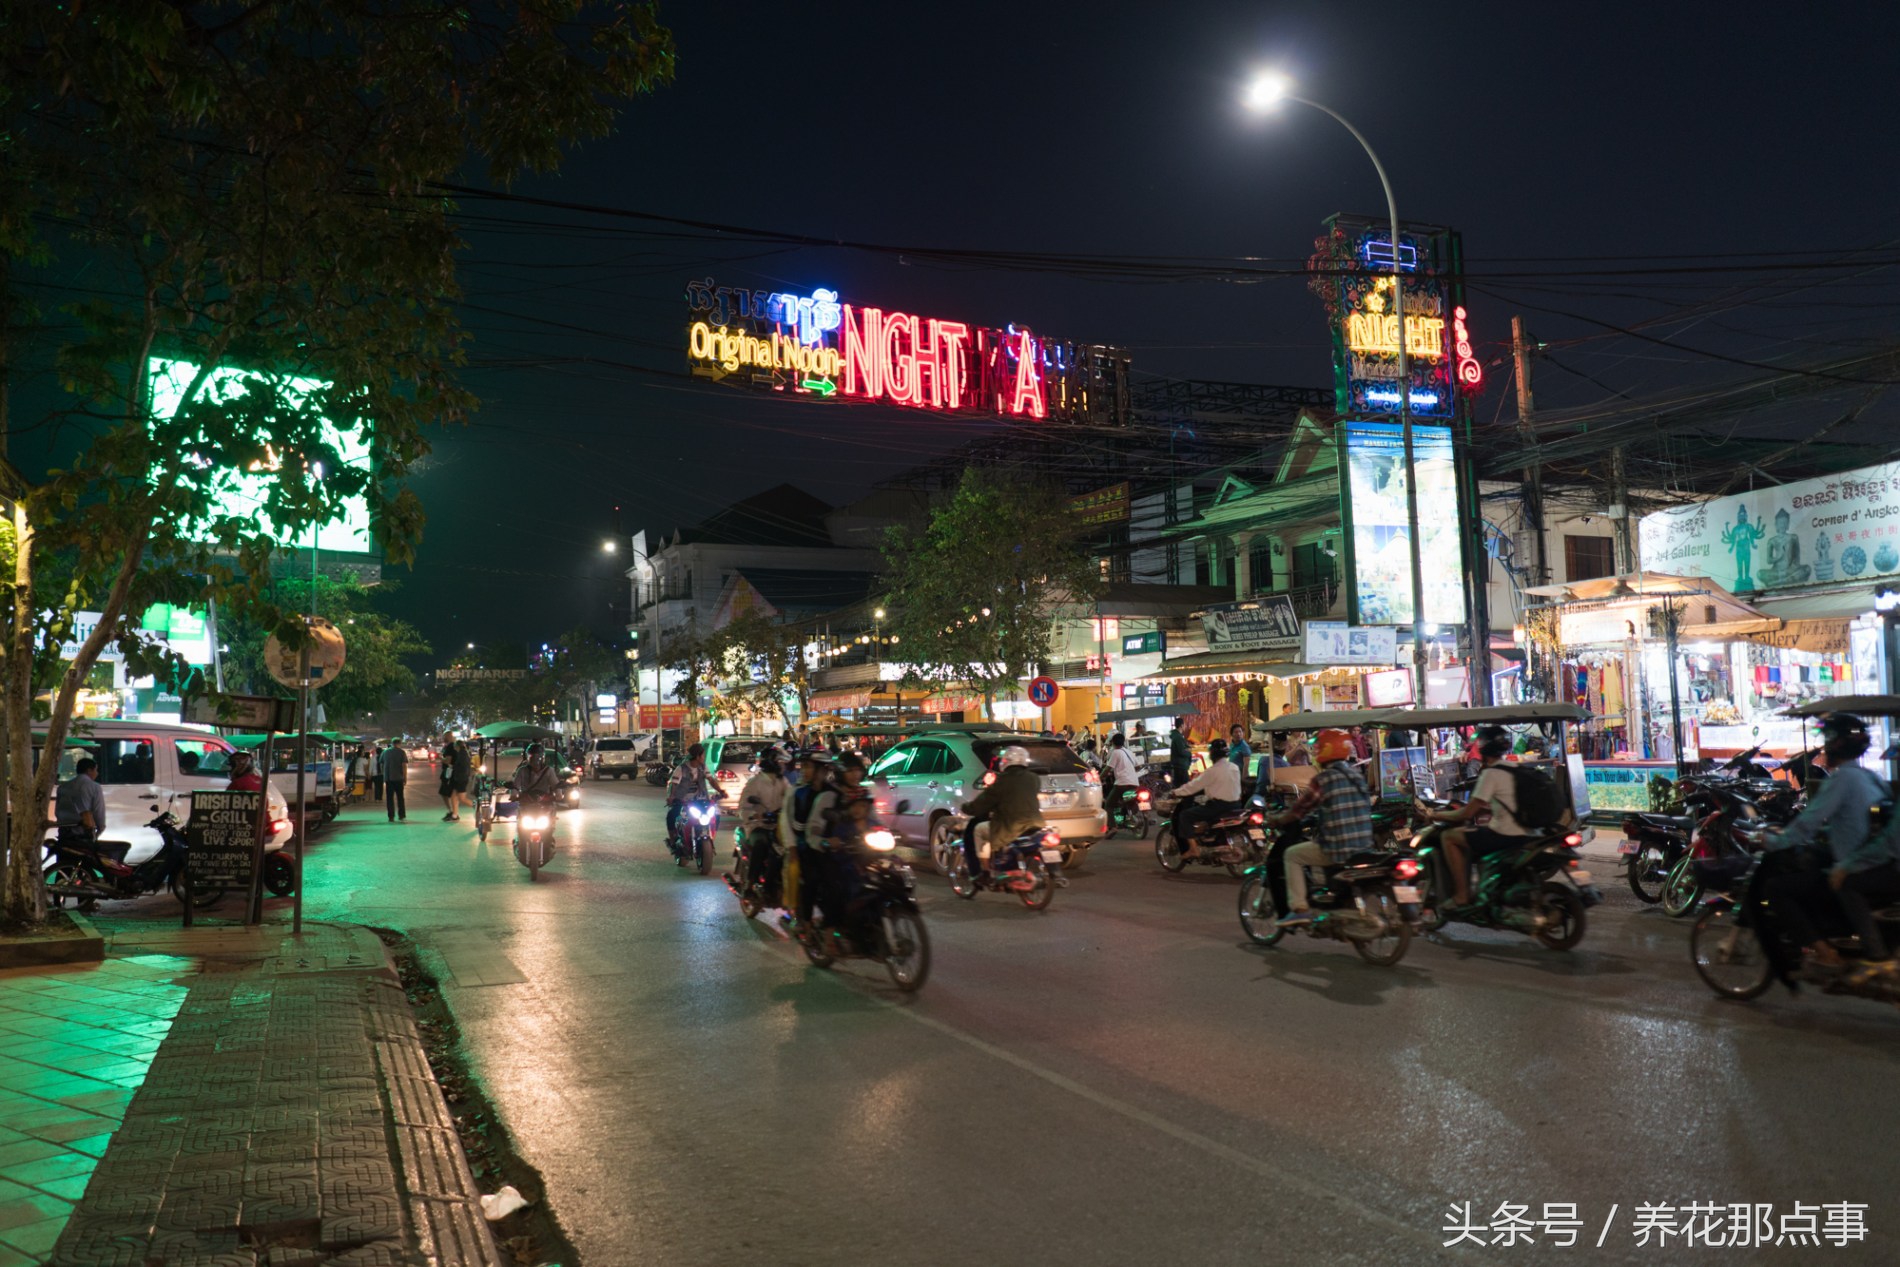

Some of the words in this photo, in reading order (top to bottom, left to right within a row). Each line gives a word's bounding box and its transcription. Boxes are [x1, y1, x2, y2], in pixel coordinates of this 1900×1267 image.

[1348, 313, 1445, 355] NIGHT
[690, 321, 782, 372] Original
[843, 303, 967, 409] NIGHT
[1811, 514, 1849, 528] Corner
[1671, 543, 1711, 560] Gallery
[1126, 639, 1142, 650] ATM
[1214, 643, 1233, 651] BODY
[1241, 641, 1260, 649] FOOT
[1262, 638, 1297, 647] MASSAGE
[436, 669, 472, 680] NIGHT
[472, 669, 527, 680] MARKET
[194, 794, 230, 810] IRISH
[210, 810, 248, 823] GRILL
[202, 829, 229, 837] GREAT
[203, 835, 226, 846] LIVE
[188, 852, 209, 860] MAD
